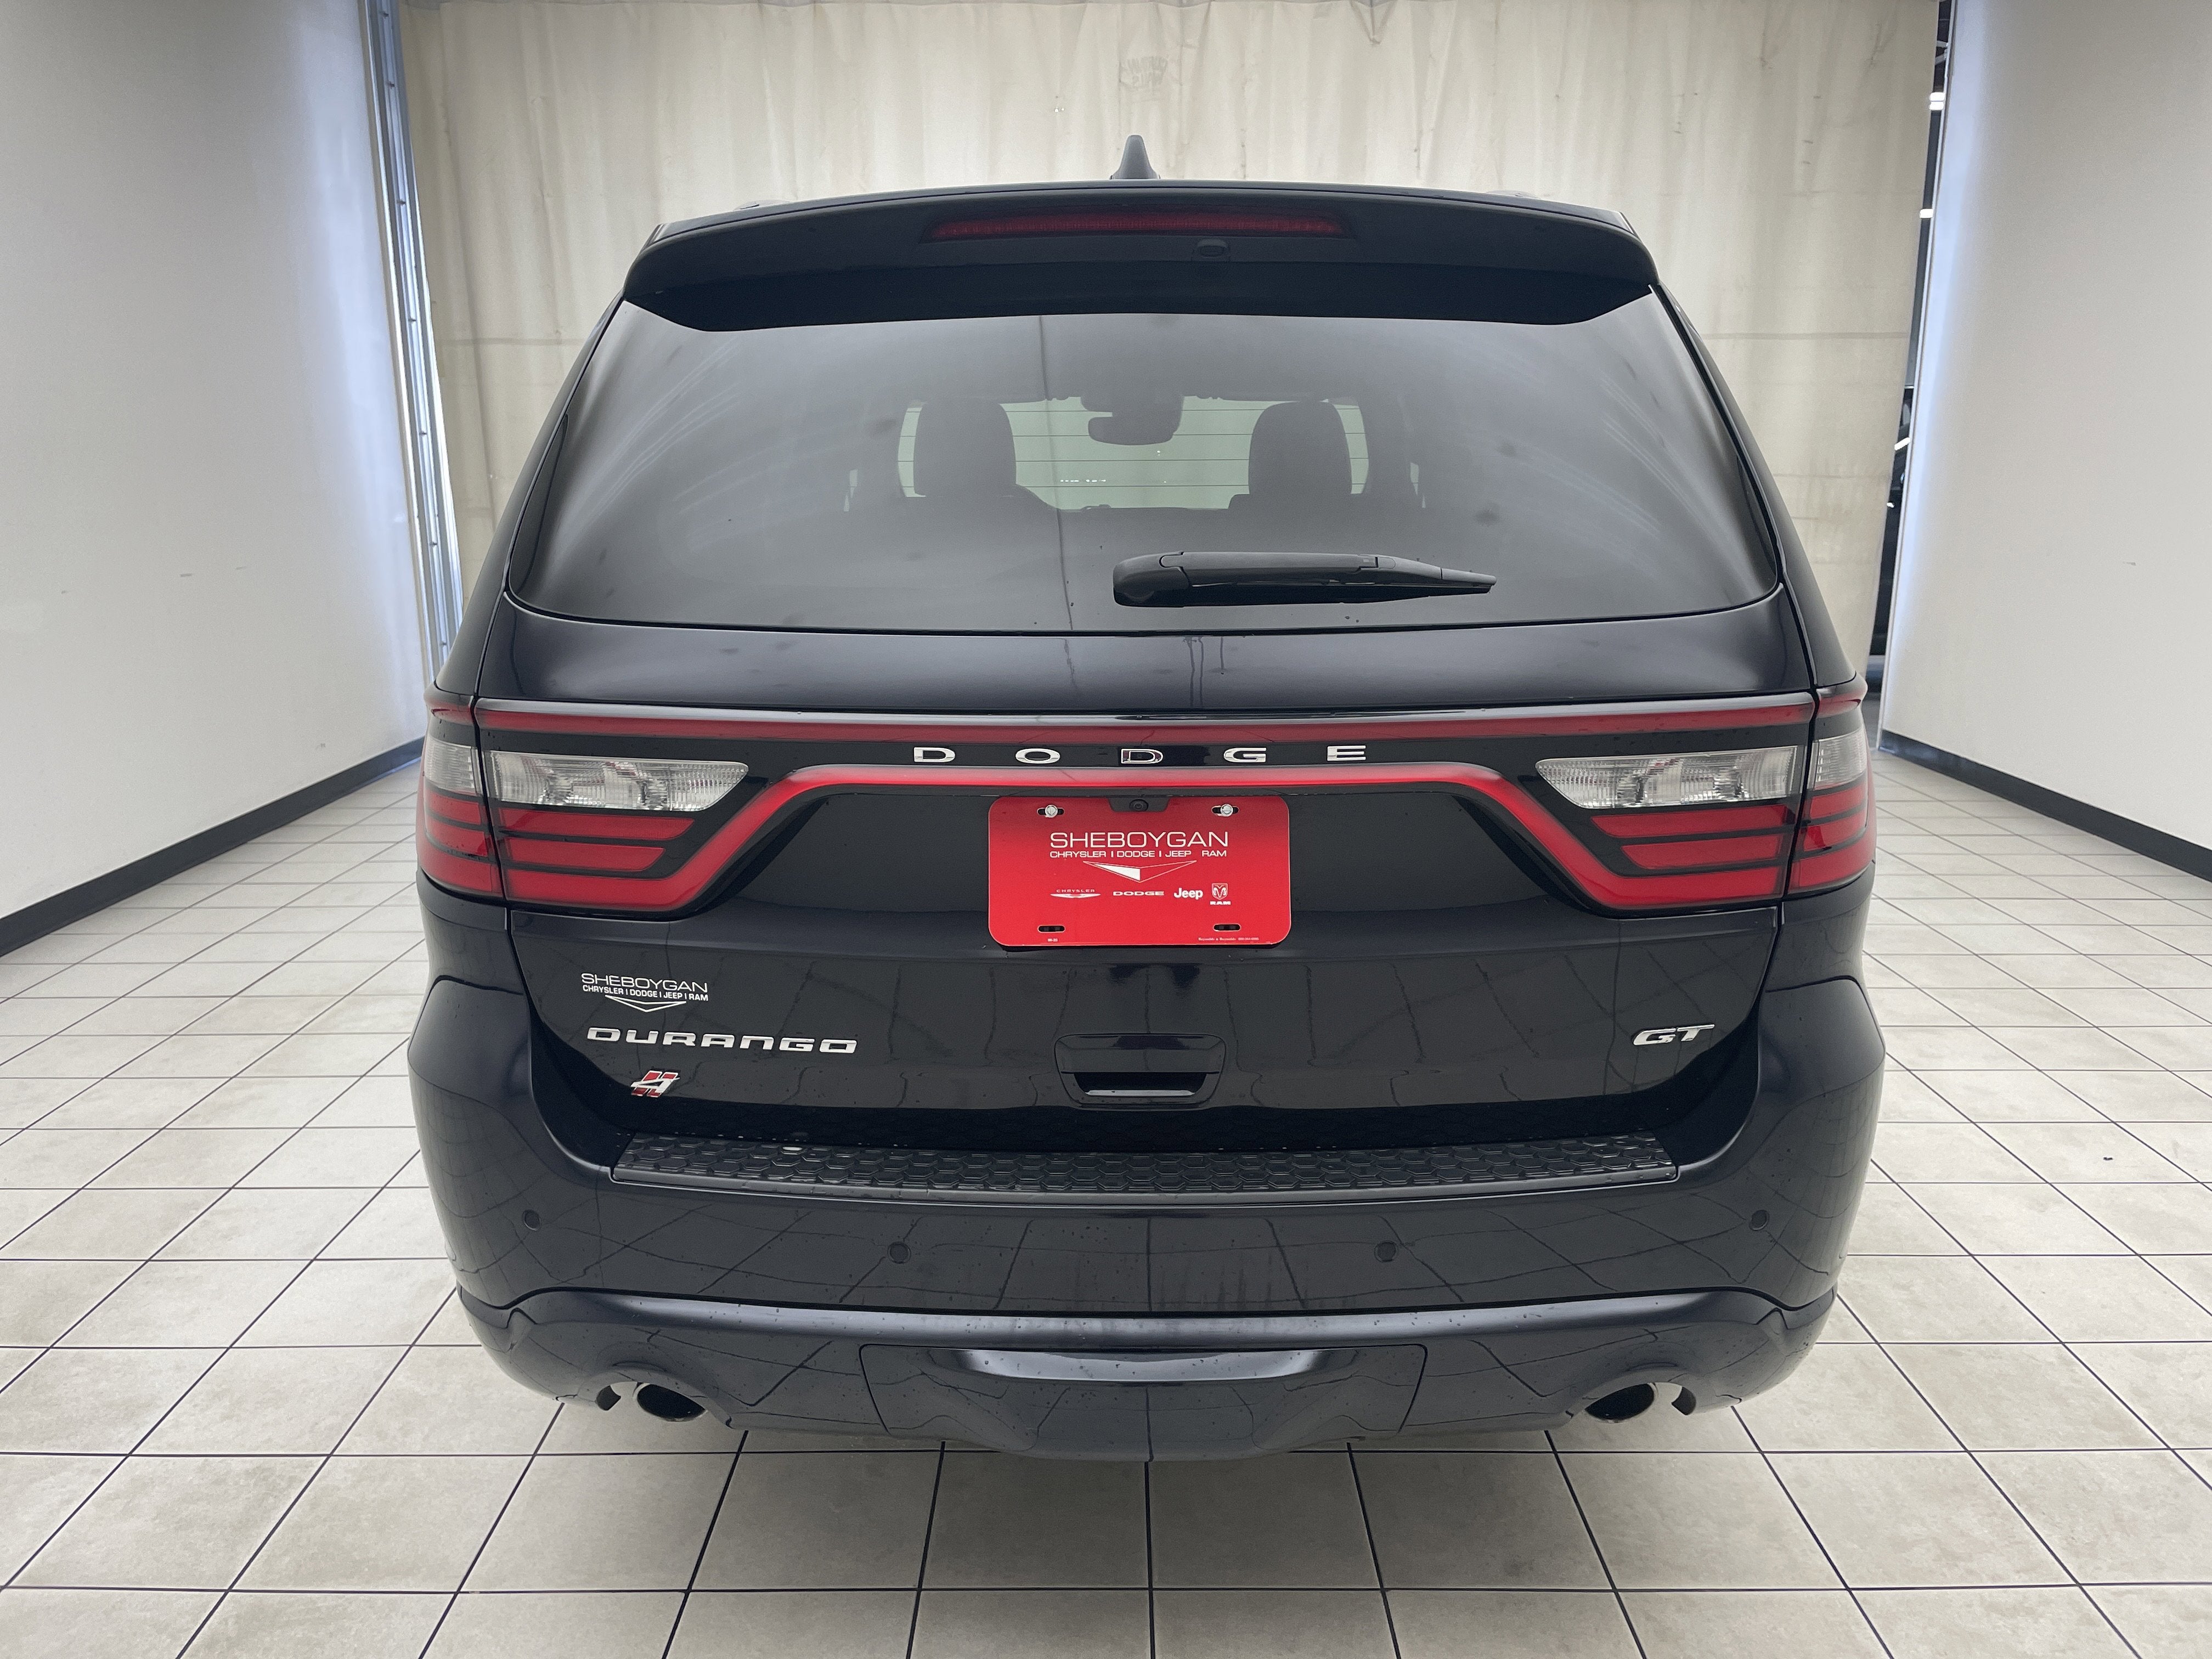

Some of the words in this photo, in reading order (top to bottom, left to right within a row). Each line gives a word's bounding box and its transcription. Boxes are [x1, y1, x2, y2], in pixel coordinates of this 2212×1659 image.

[913, 745, 1367, 764] DODGE
[1049, 831, 1228, 848] SHEBOYGAN
[1173, 887, 1204, 900] Jeep
[580, 973, 708, 993] SHEBOYGAN
[582, 984, 624, 995] CHRYSLER
[629, 988, 658, 998] DODGE
[663, 991, 683, 1000] JEEP
[586, 1026, 857, 1054] DURANGO
[1633, 1023, 1716, 1046] GT
